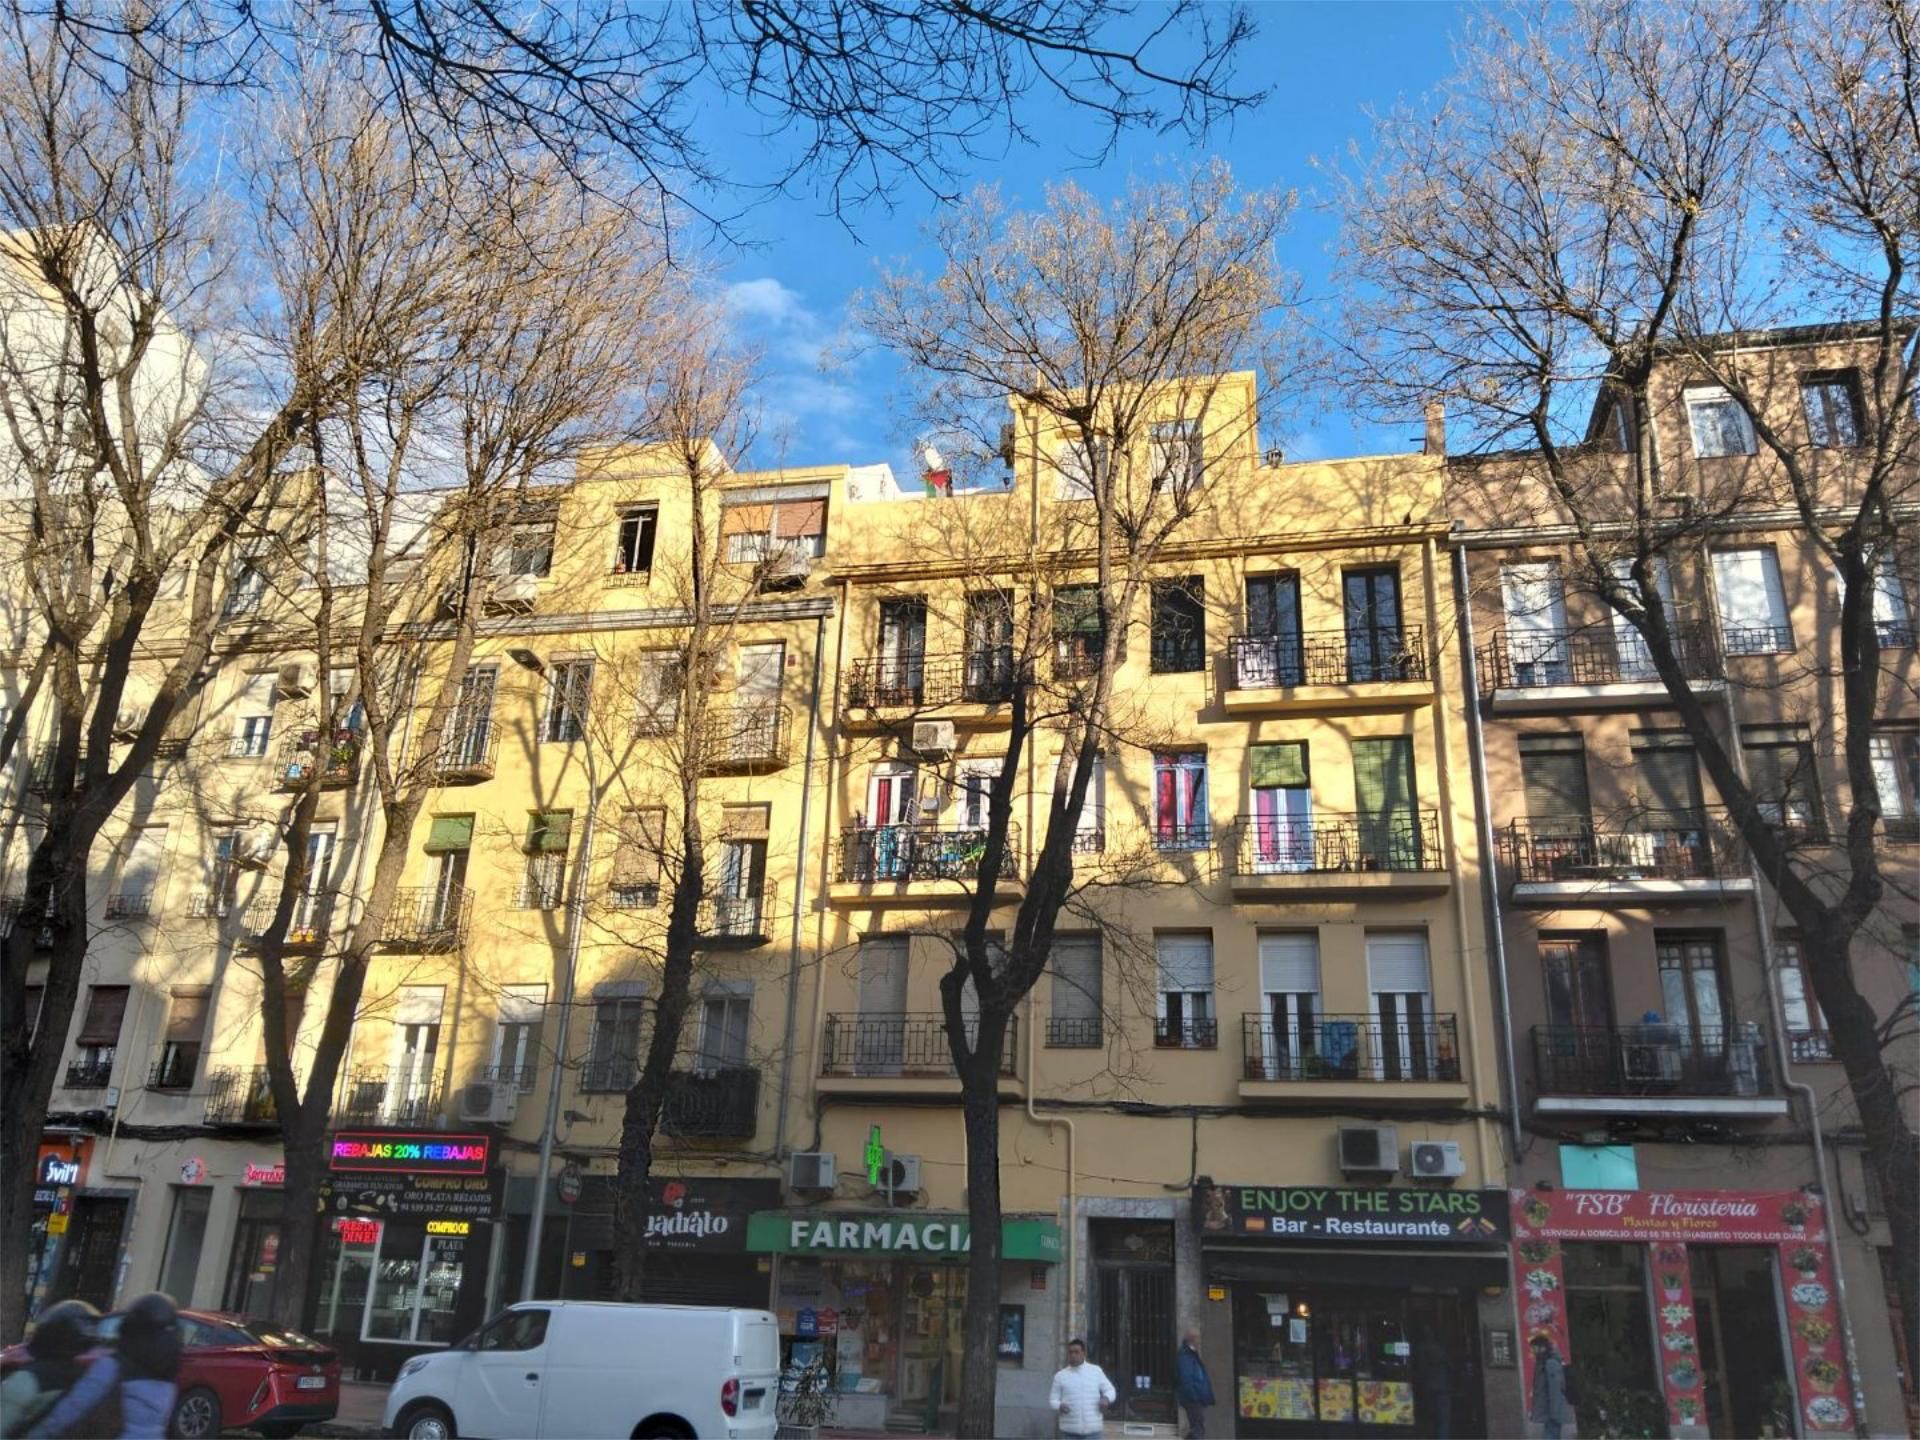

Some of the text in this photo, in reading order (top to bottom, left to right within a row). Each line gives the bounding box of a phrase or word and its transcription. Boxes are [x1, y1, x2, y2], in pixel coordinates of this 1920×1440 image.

[333, 1142, 485, 1161] REBAJAS 20% REBAJAS
[464, 1179, 489, 1191] ORO
[403, 1191, 424, 1200] ORO
[424, 1191, 452, 1201] PLATA
[1240, 1190, 1482, 1214] ENJOY THE STARS
[1271, 1216, 1306, 1233] Bar
[1325, 1217, 1451, 1236] Restaurante
[1681, 1217, 1719, 1229] Flores
[1540, 1228, 1579, 1238] SERVICIO
[1579, 1229, 1587, 1238] A
[1732, 1231, 1762, 1240] TODOS
[1763, 1231, 1782, 1240] LOS
